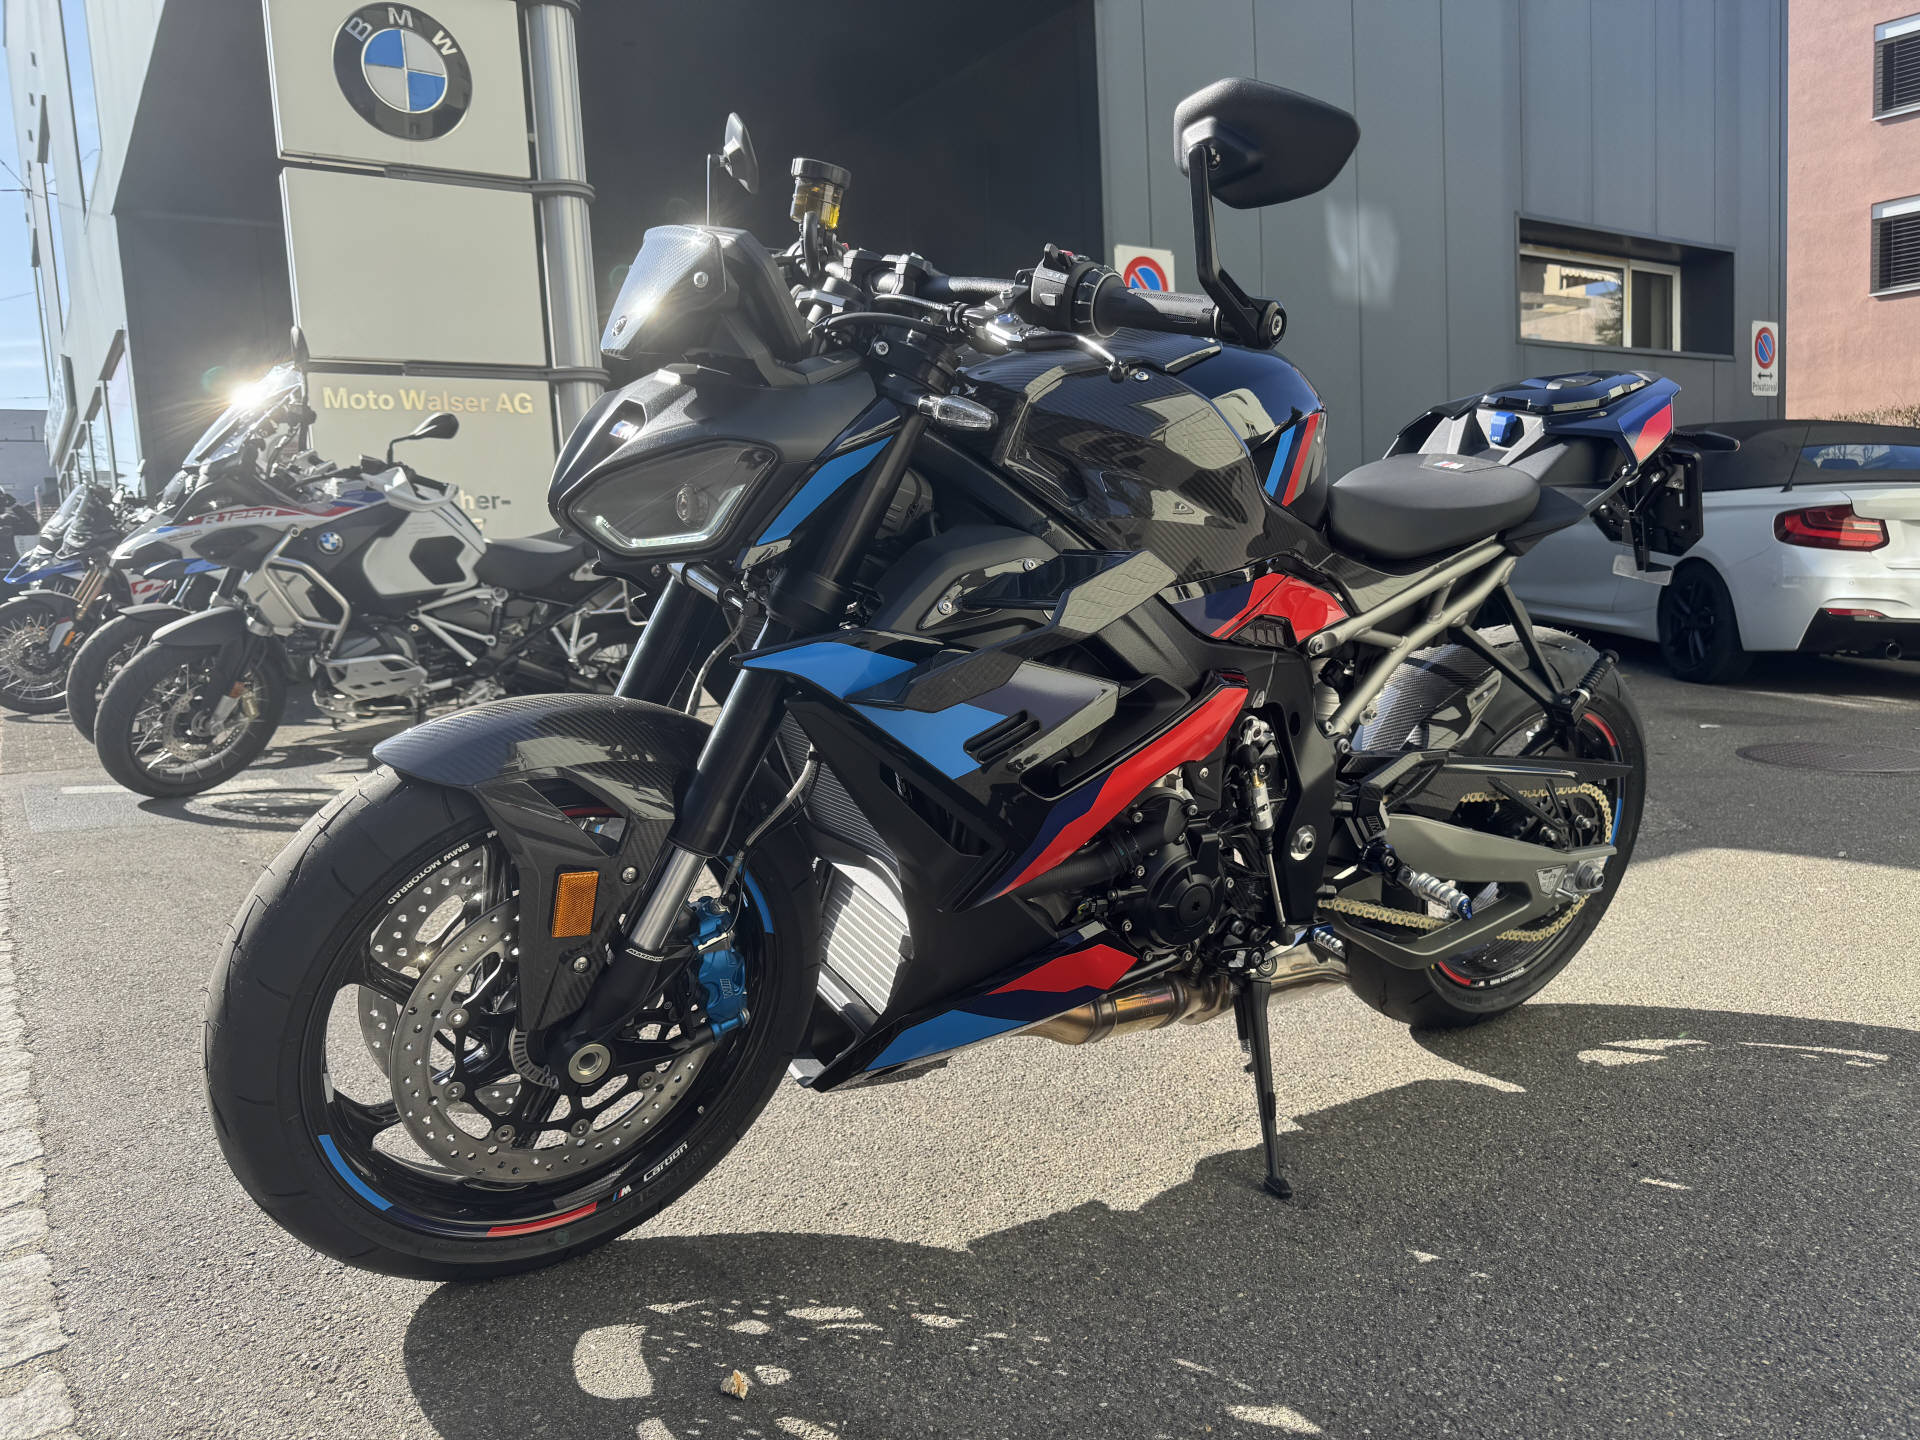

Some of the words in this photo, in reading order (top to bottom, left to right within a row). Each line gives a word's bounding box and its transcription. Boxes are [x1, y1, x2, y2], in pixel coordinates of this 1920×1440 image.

[345, 7, 458, 56] BMW
[322, 386, 395, 411] Moto
[398, 388, 490, 413] Walser
[495, 392, 534, 415] AG
[460, 489, 512, 512] her-
[443, 842, 470, 861] BMW
[387, 859, 442, 905] MOTORRAD
[643, 1140, 688, 1182] Carbon
